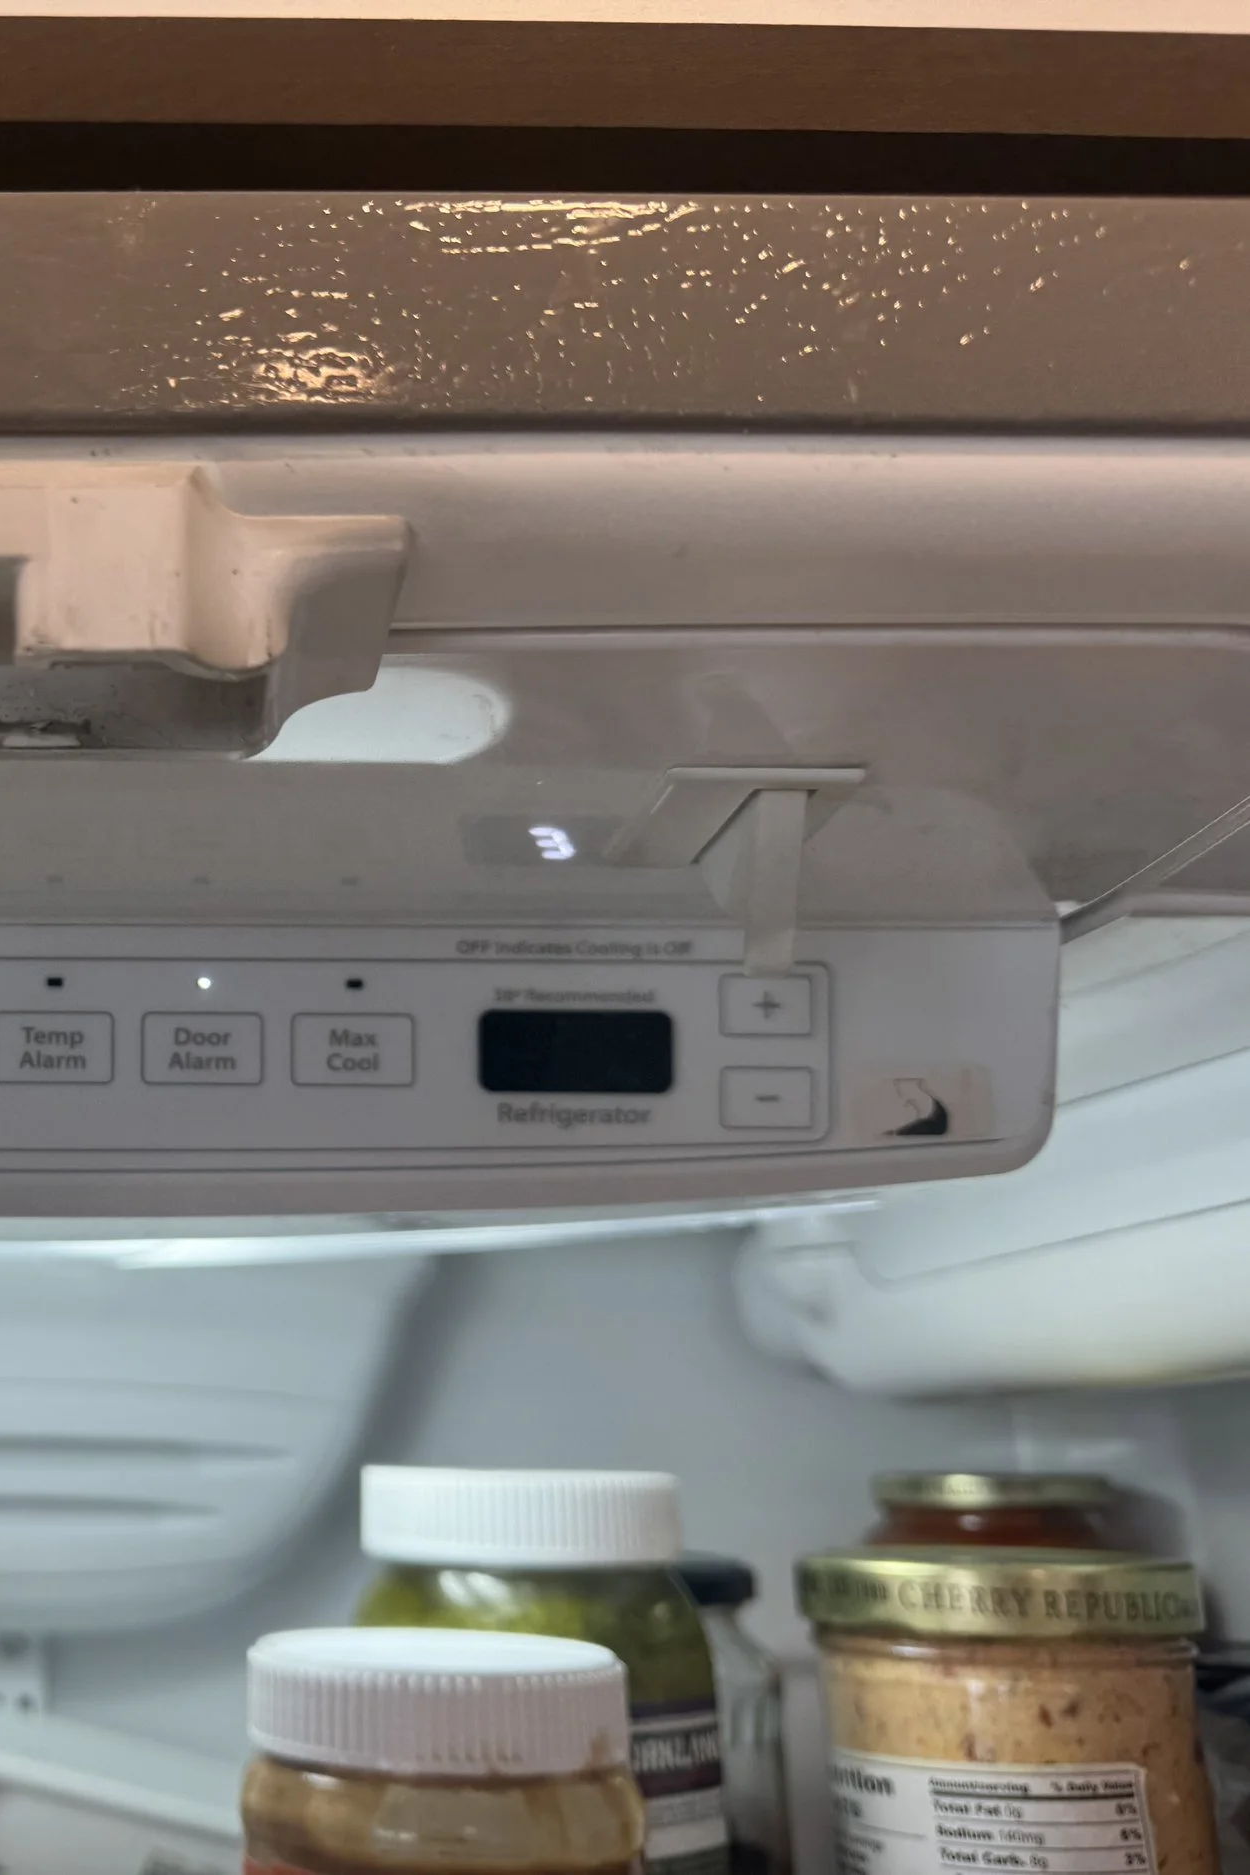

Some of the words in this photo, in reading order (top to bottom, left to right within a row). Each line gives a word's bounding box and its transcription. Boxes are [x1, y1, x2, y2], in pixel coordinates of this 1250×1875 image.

[455, 939, 491, 955] OFF
[575, 939, 643, 959] Cooling
[525, 987, 655, 1003] Recommended
[22, 1026, 84, 1049] Temp
[174, 1027, 231, 1047] Door
[329, 1028, 377, 1048] Max
[19, 1051, 87, 1070] Alarm
[168, 1052, 237, 1071] Alarm
[326, 1052, 380, 1072] Cool
[497, 1102, 652, 1129] Refrigerator
[897, 1579, 1031, 1618] CHERRY
[1044, 1588, 1182, 1622] REPUBLIC
[933, 1799, 969, 1815] Total
[976, 1801, 1001, 1817] Fat
[937, 1823, 993, 1841] Sodium
[940, 1848, 978, 1866] Total
